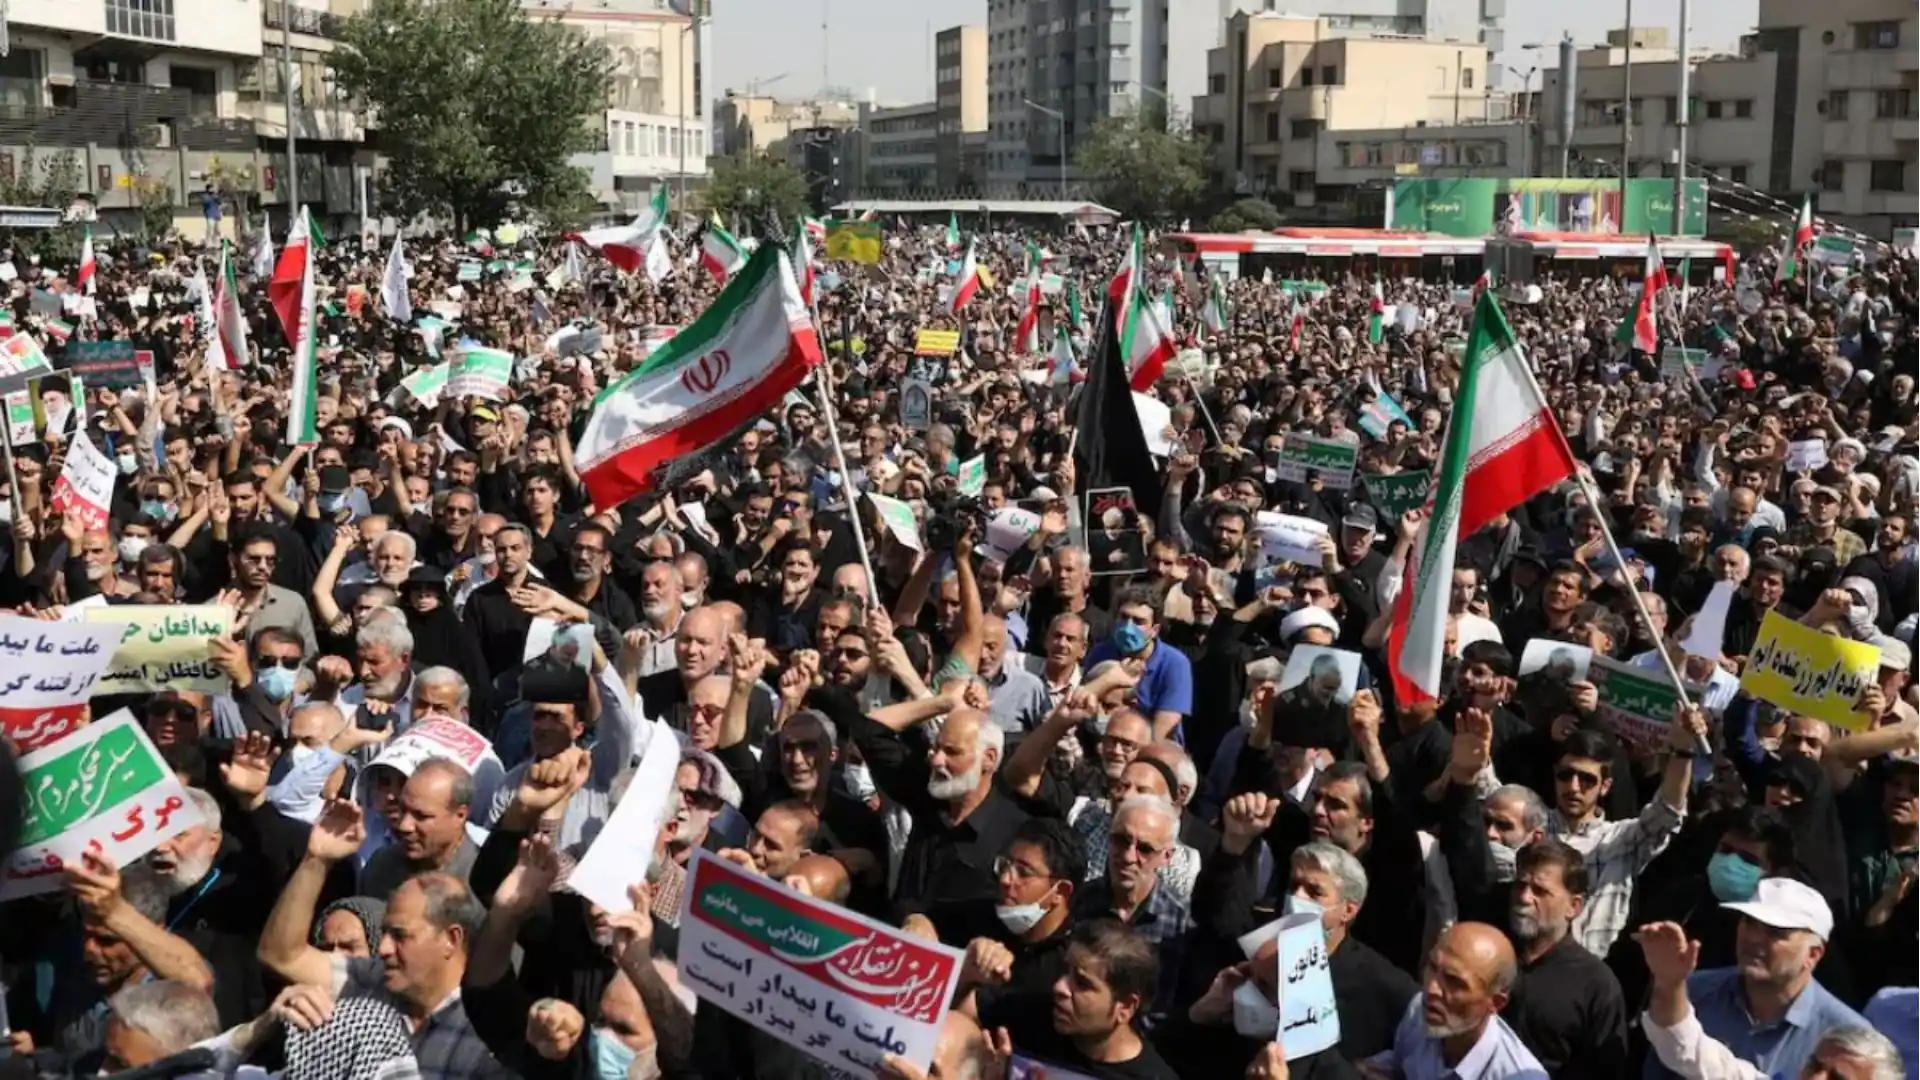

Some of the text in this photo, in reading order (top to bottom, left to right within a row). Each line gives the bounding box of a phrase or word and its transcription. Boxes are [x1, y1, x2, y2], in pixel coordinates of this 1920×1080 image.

[0, 633, 100, 657] ملت ما بید
[149, 613, 222, 643] مدافعان
[33, 671, 72, 693] فتنه
[70, 671, 98, 697] از
[156, 658, 222, 684] حافظان
[12, 711, 68, 744] مرگ
[37, 775, 79, 823] مردم
[111, 796, 183, 843] مرگ
[704, 890, 821, 952] انقلابی می مانیم
[685, 961, 735, 998] است
[701, 939, 907, 1056] ملت ما بیدار است
[742, 997, 796, 1035] بیزار
